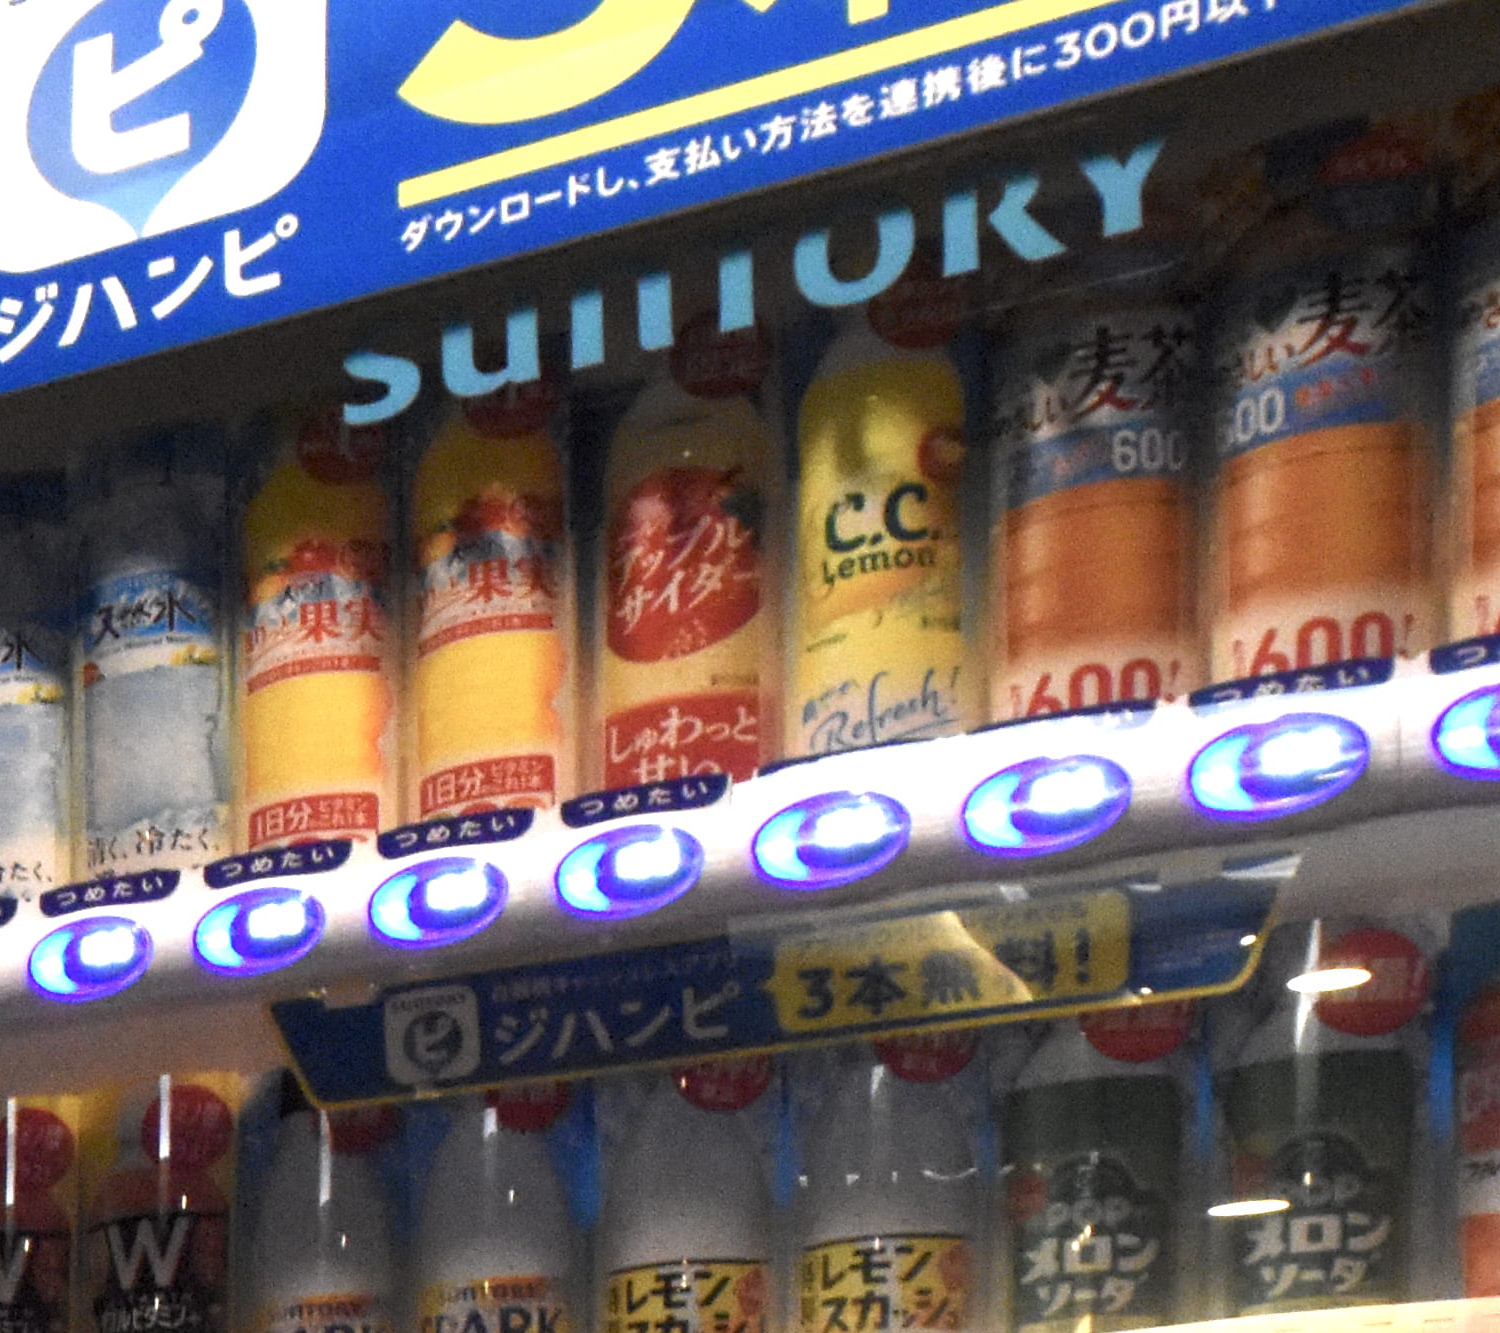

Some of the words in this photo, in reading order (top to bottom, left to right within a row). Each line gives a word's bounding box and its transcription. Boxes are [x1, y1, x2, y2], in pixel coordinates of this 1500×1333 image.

[822, 543, 937, 585] Lemon
[616, 560, 760, 635] サイダー
[610, 706, 758, 763] しゅわっと
[426, 766, 486, 807] 1日分
[581, 777, 710, 815] つめたい
[254, 804, 312, 842] 1日分
[396, 813, 520, 849] つめたい
[223, 846, 336, 877] つめたい
[52, 875, 166, 905] つめたい
[490, 978, 740, 1065] ジハンピ
[108, 1215, 191, 1289] W
[1024, 1231, 1156, 1278] メロン
[1246, 1212, 1391, 1263] メロン
[822, 1236, 933, 1286] レモン
[1261, 1256, 1368, 1294] ソーダ
[624, 1262, 732, 1316] レモン
[1038, 1278, 1138, 1317] ソーダ
